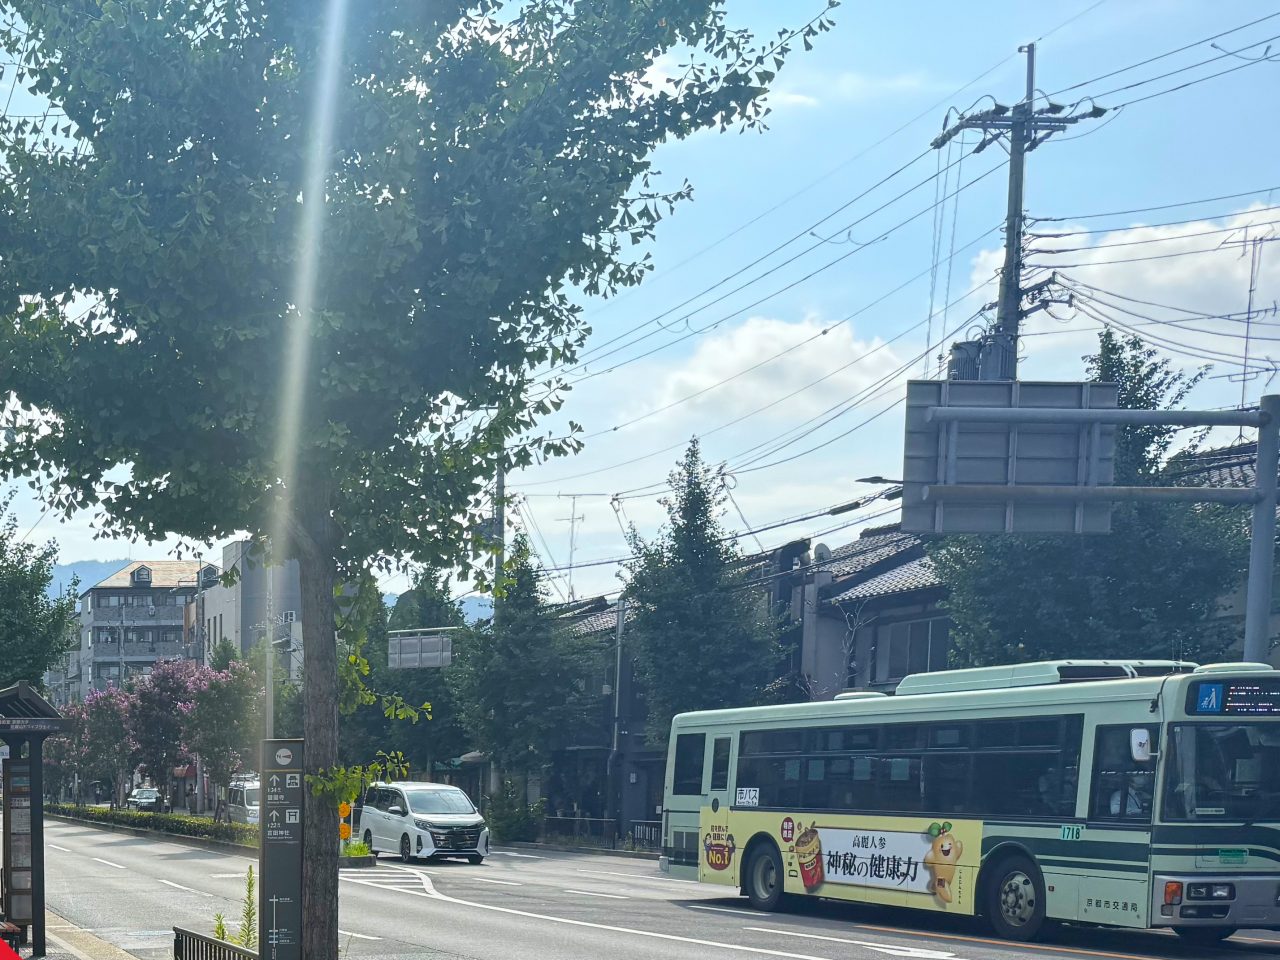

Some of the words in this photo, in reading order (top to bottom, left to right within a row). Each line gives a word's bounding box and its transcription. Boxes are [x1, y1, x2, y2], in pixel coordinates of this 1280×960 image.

[738, 789, 758, 800] 市バス
[1062, 826, 1081, 839] 1718
[852, 835, 887, 850] 高麗人参
[709, 847, 729, 865] No.1
[827, 850, 919, 886] 神秘の健康力
[1086, 898, 1138, 912] 京都市交通局
